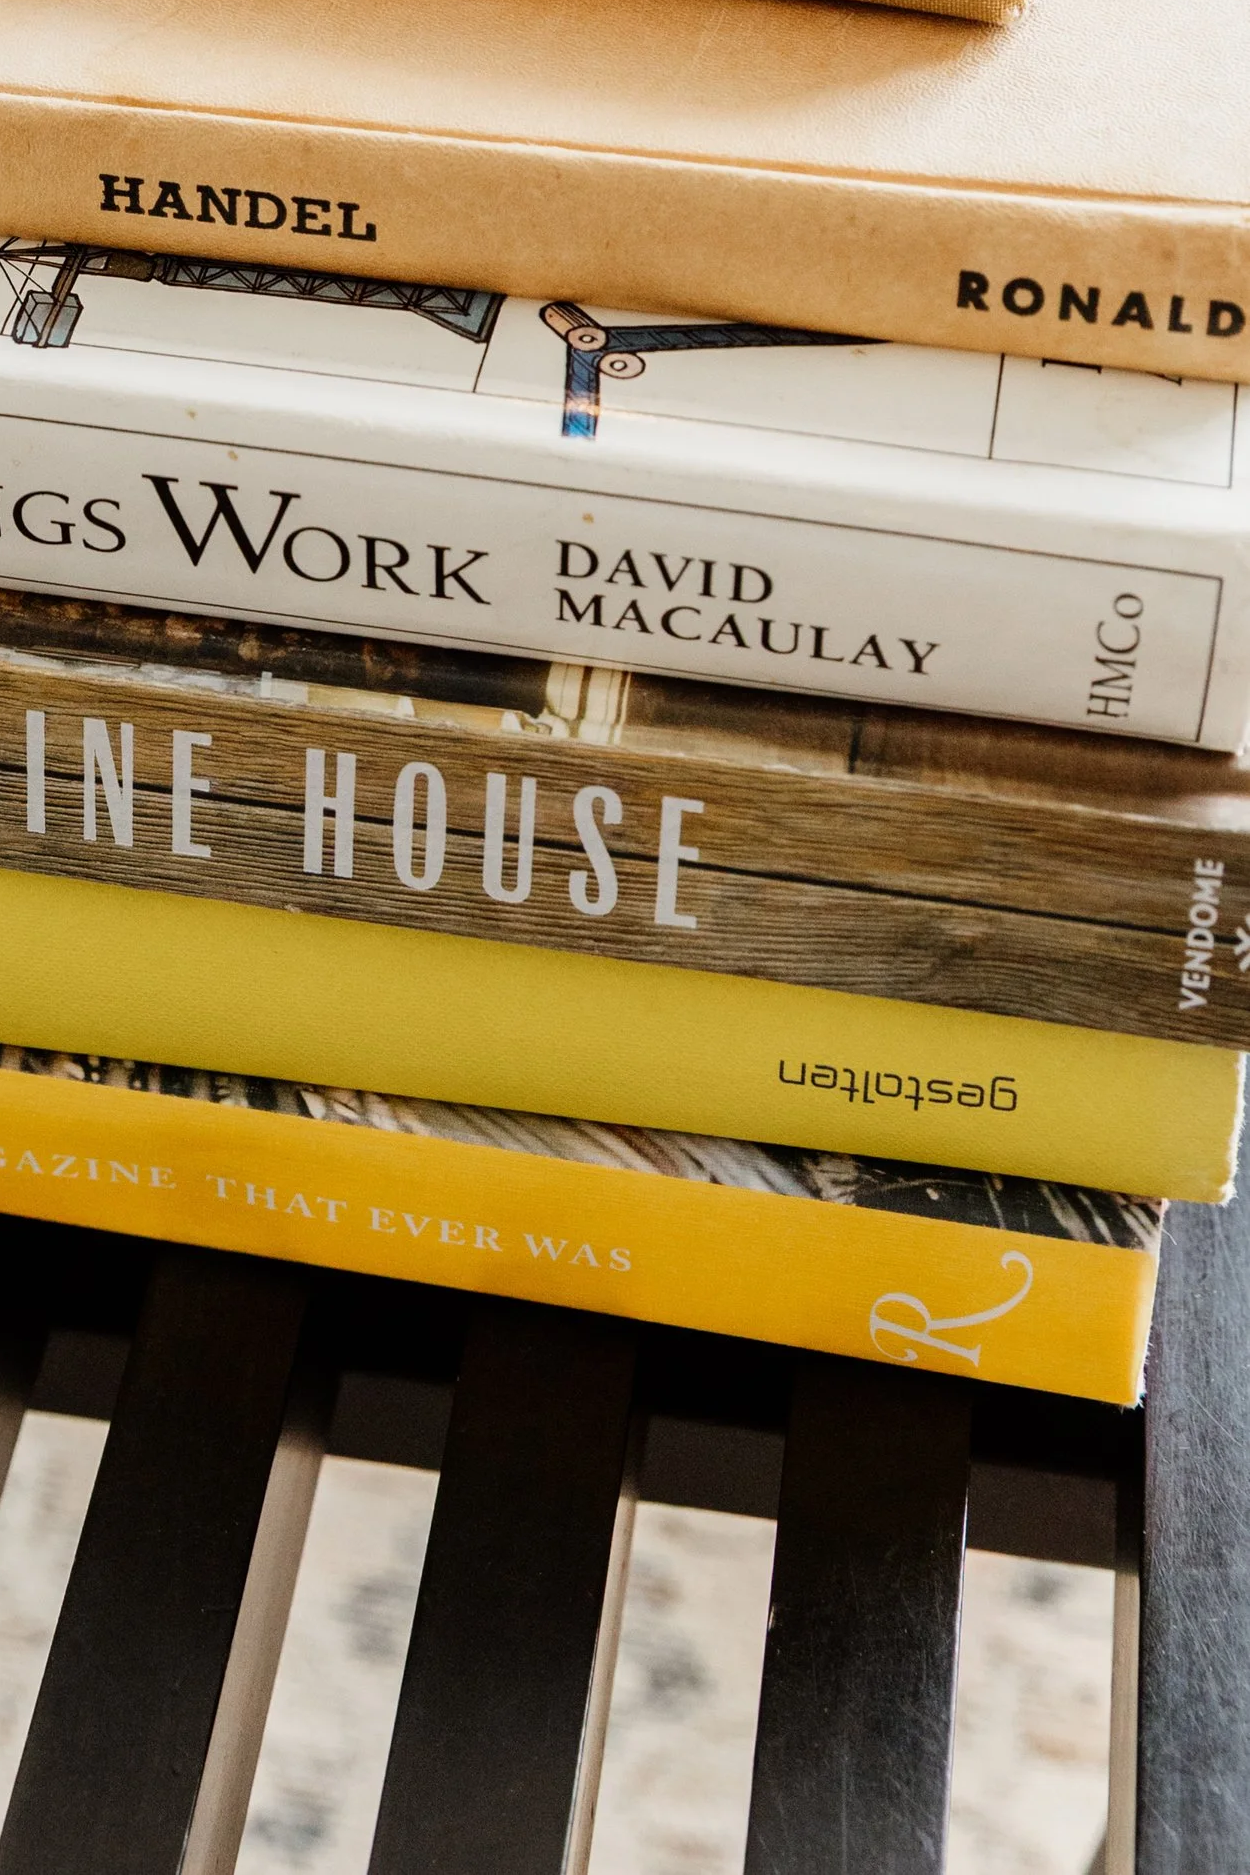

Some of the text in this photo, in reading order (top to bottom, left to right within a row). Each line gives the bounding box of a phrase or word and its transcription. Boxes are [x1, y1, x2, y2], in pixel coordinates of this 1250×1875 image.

[99, 173, 377, 242] HANDEL
[956, 270, 1247, 338] RONALD
[555, 539, 774, 604] DAVID
[554, 588, 940, 675] MACAULAY
[1087, 592, 1145, 721] HMCo
[303, 748, 705, 929] HOUSE
[1178, 858, 1225, 1010] VENDOME
[777, 1059, 1019, 1112] gestalten
[205, 1173, 348, 1224] THAT
[368, 1207, 503, 1252] EVER
[523, 1232, 633, 1272] WAS
